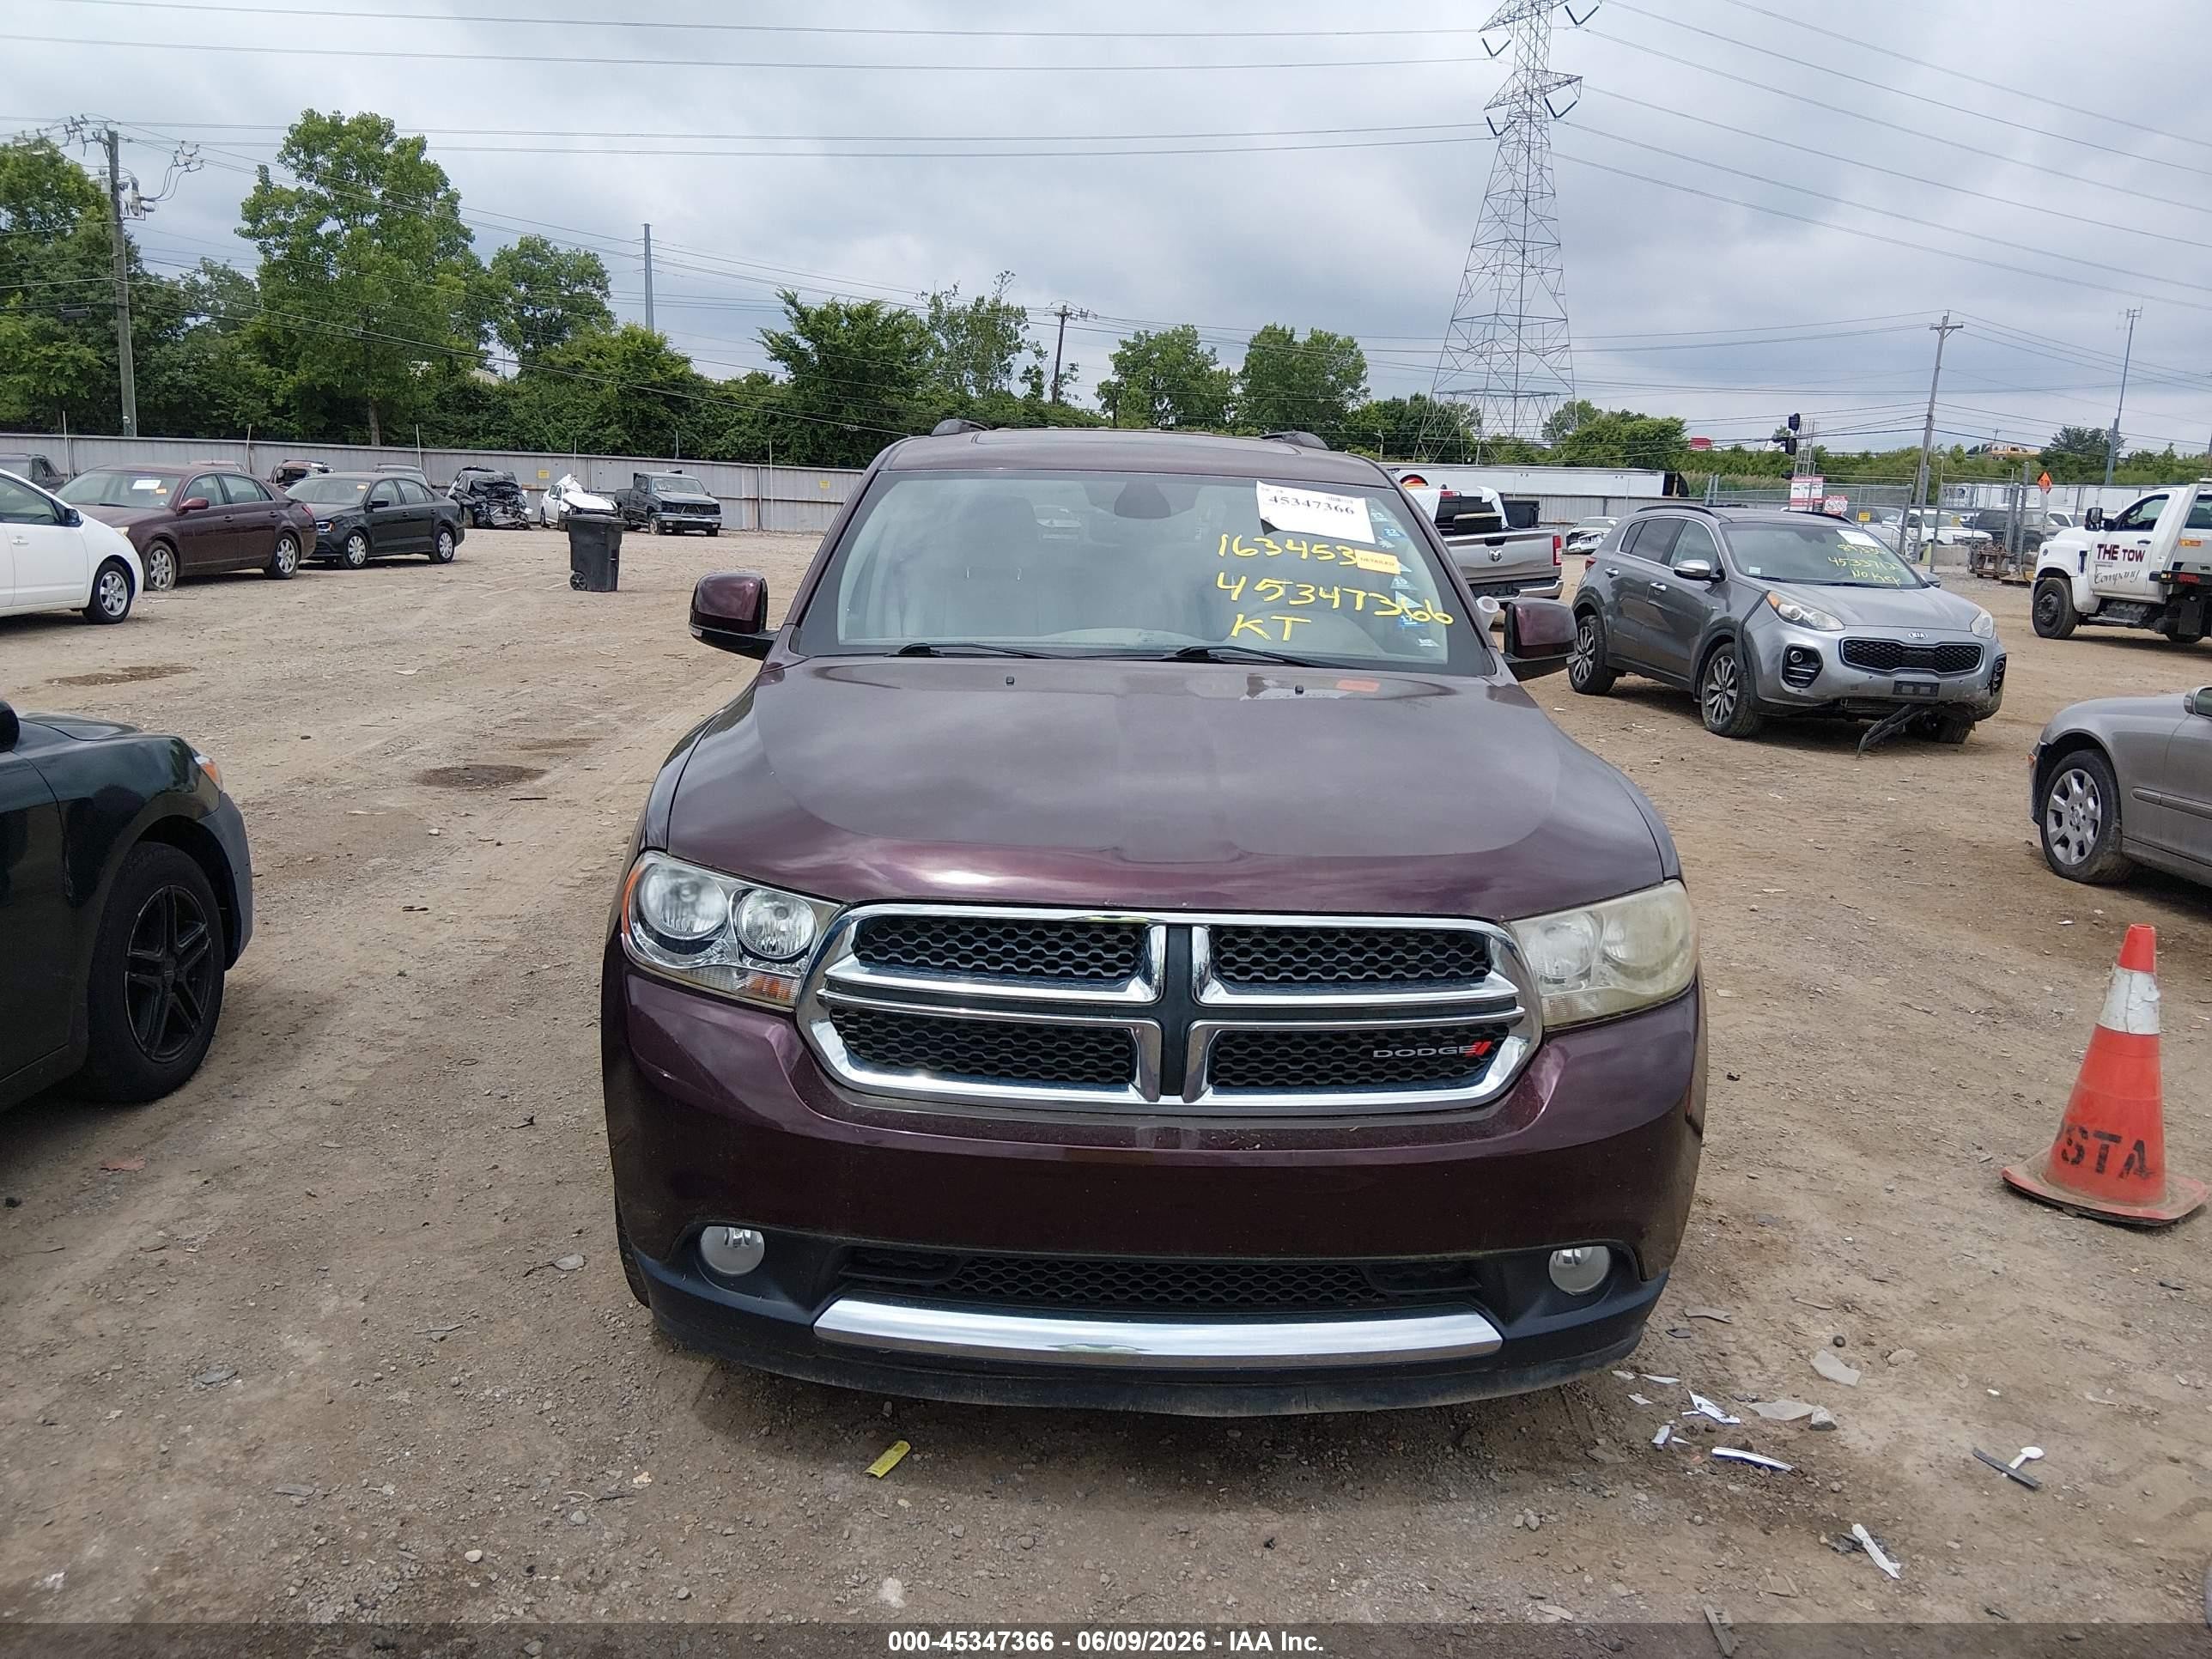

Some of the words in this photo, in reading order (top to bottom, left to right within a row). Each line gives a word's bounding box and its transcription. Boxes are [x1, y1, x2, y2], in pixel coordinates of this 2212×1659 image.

[1268, 495, 1355, 515] 45347366
[1218, 533, 1358, 567] 163453
[2096, 544, 2119, 561] THE
[2122, 549, 2146, 562] TOW
[1216, 572, 1455, 625] 45347366
[1909, 631, 1927, 640] KIA
[1373, 1045, 1476, 1058] DODGE
[2056, 1120, 2155, 1180] STA
